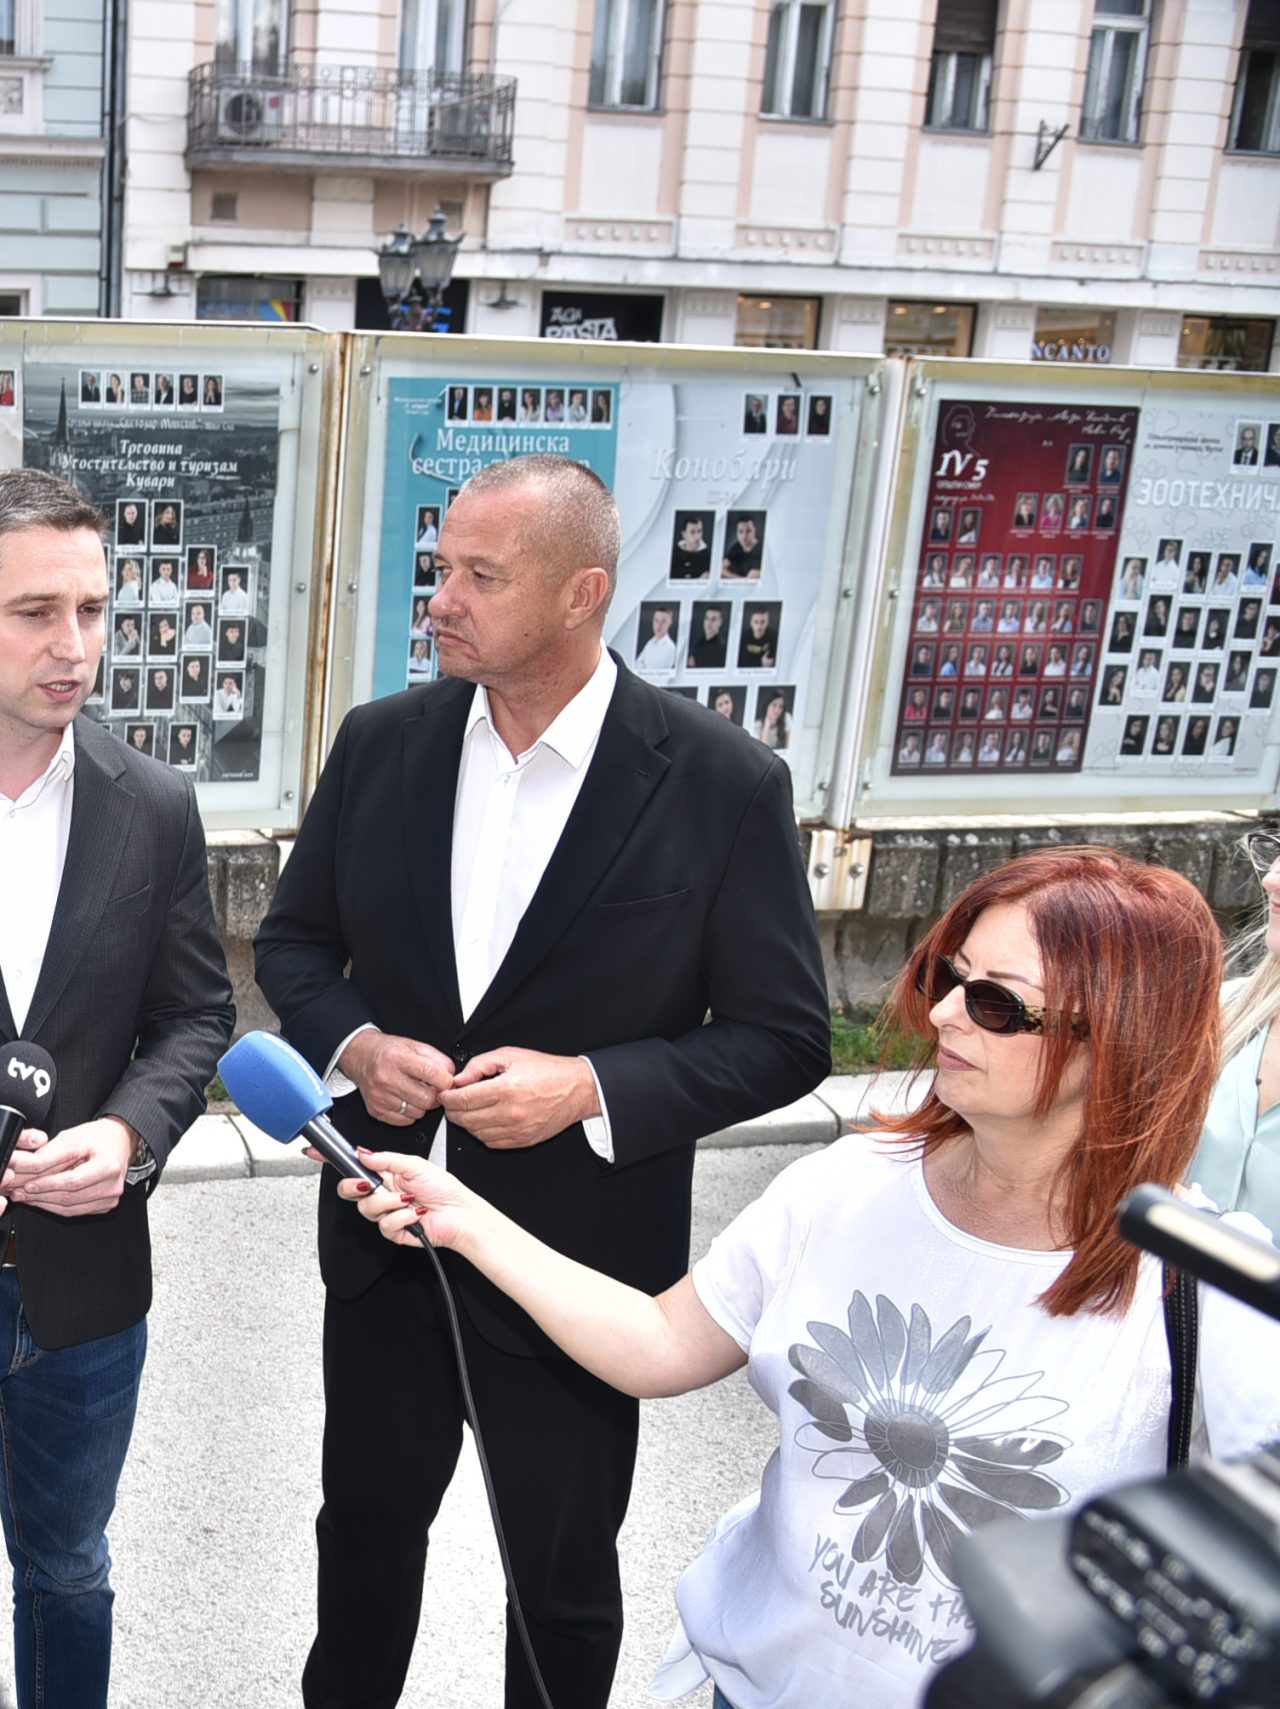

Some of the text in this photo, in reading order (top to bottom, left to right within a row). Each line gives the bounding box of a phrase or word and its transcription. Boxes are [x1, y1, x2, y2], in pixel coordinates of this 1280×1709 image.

[119, 439, 183, 457] Трговина
[435, 427, 570, 455] Медицинска
[168, 460, 177, 470] и
[180, 459, 239, 476] туризам
[650, 448, 798, 491] Конобари
[934, 449, 990, 481] IV 5
[125, 472, 176, 491] Кувари
[1136, 479, 1280, 512] ЗООТЕХНИЧ
[808, 1533, 855, 1590] YOU
[859, 1569, 923, 1613] ARE
[819, 1580, 960, 1665] SUNSHINE
